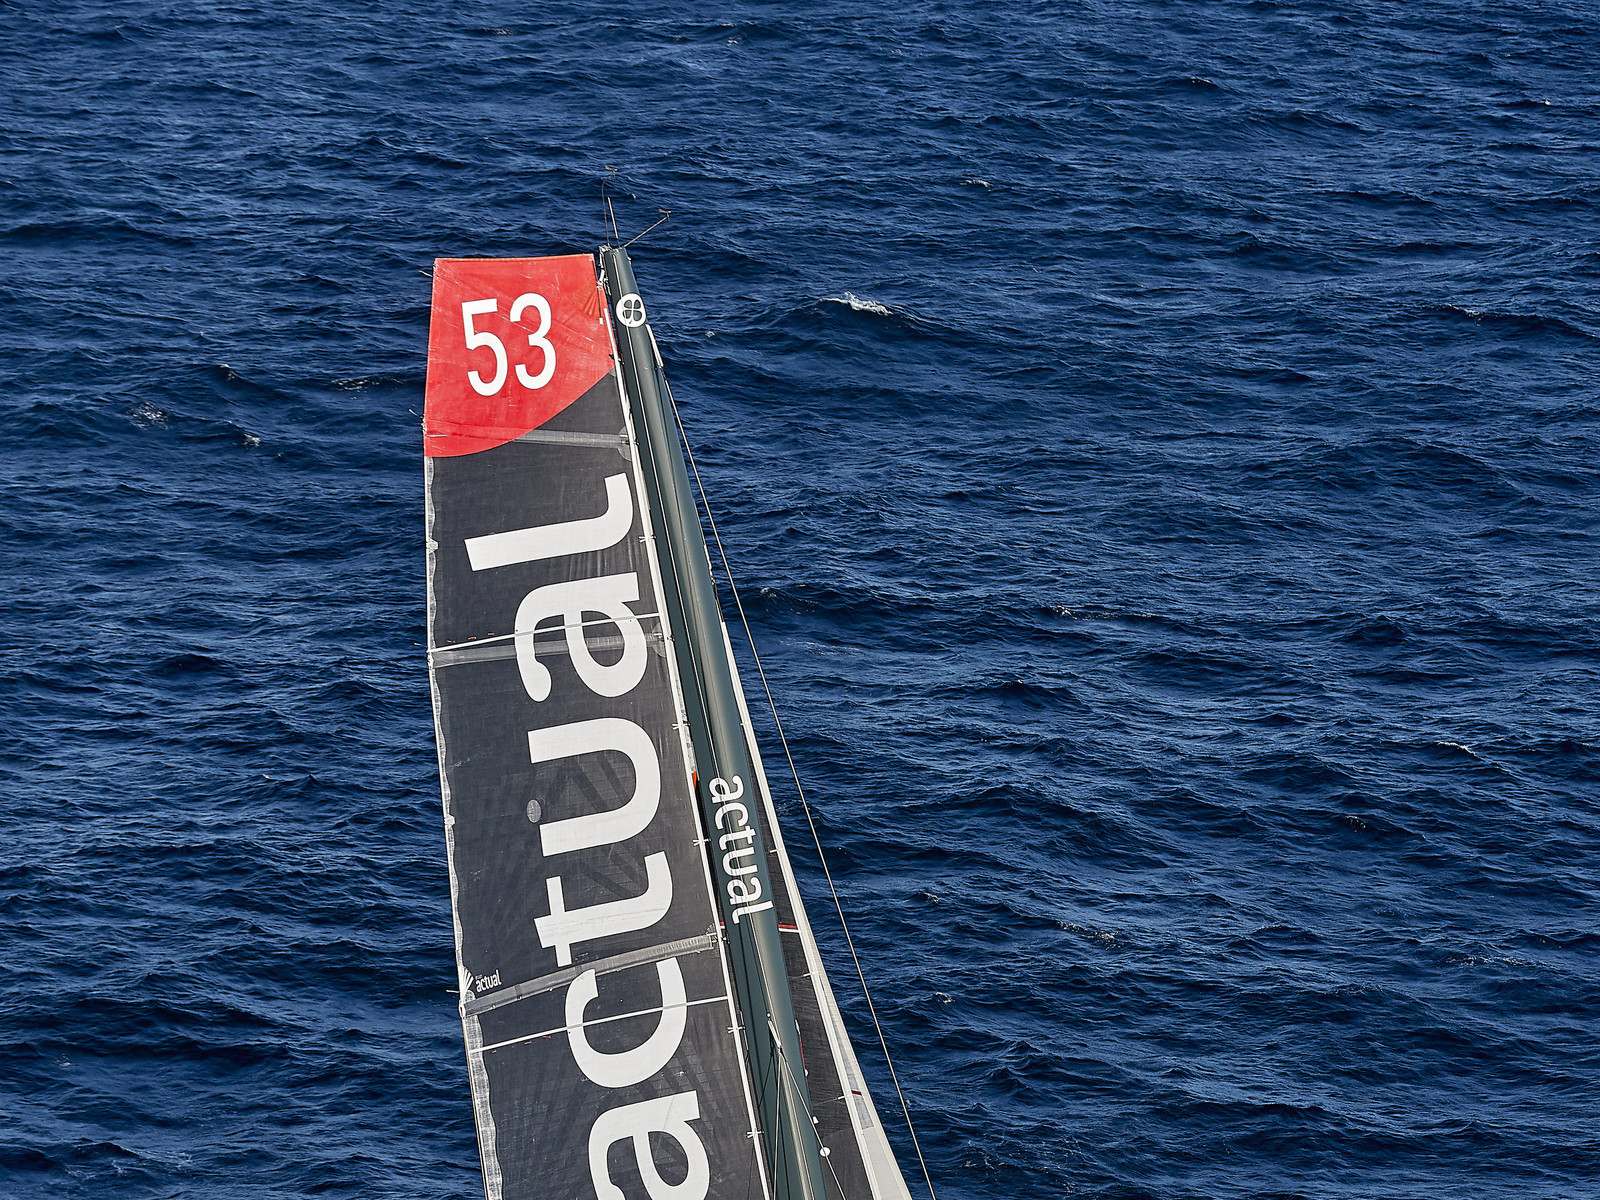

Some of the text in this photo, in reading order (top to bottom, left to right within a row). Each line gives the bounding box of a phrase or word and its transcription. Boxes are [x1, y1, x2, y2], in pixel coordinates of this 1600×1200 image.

[461, 293, 557, 396] 53
[708, 775, 774, 924] actual
[475, 969, 502, 993] actual
